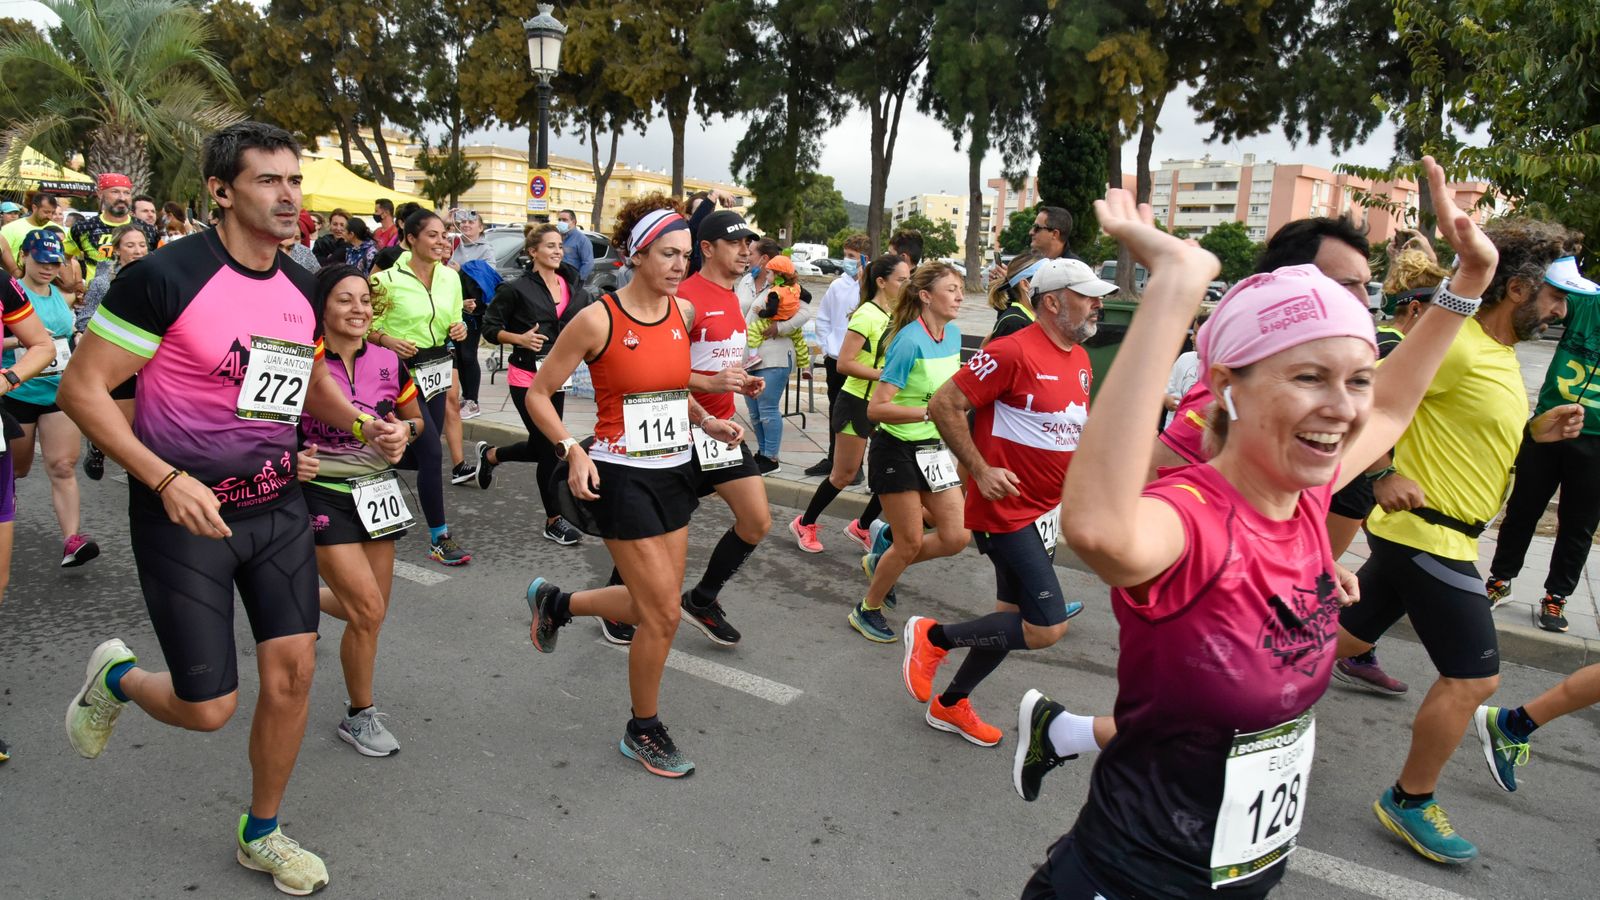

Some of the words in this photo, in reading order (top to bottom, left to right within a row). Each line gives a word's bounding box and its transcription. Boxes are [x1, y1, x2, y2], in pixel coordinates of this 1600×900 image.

[263, 354, 283, 365] JUAN
[711, 348, 730, 358] SAN
[253, 371, 303, 406] 272
[422, 372, 441, 391] 250
[651, 403, 668, 412] PILAR
[639, 417, 675, 443] 114
[1041, 422, 1066, 434] SAN
[702, 440, 719, 459] 13
[367, 495, 400, 524] 210
[953, 631, 1008, 649] Kalenji
[1248, 773, 1301, 845] 128
